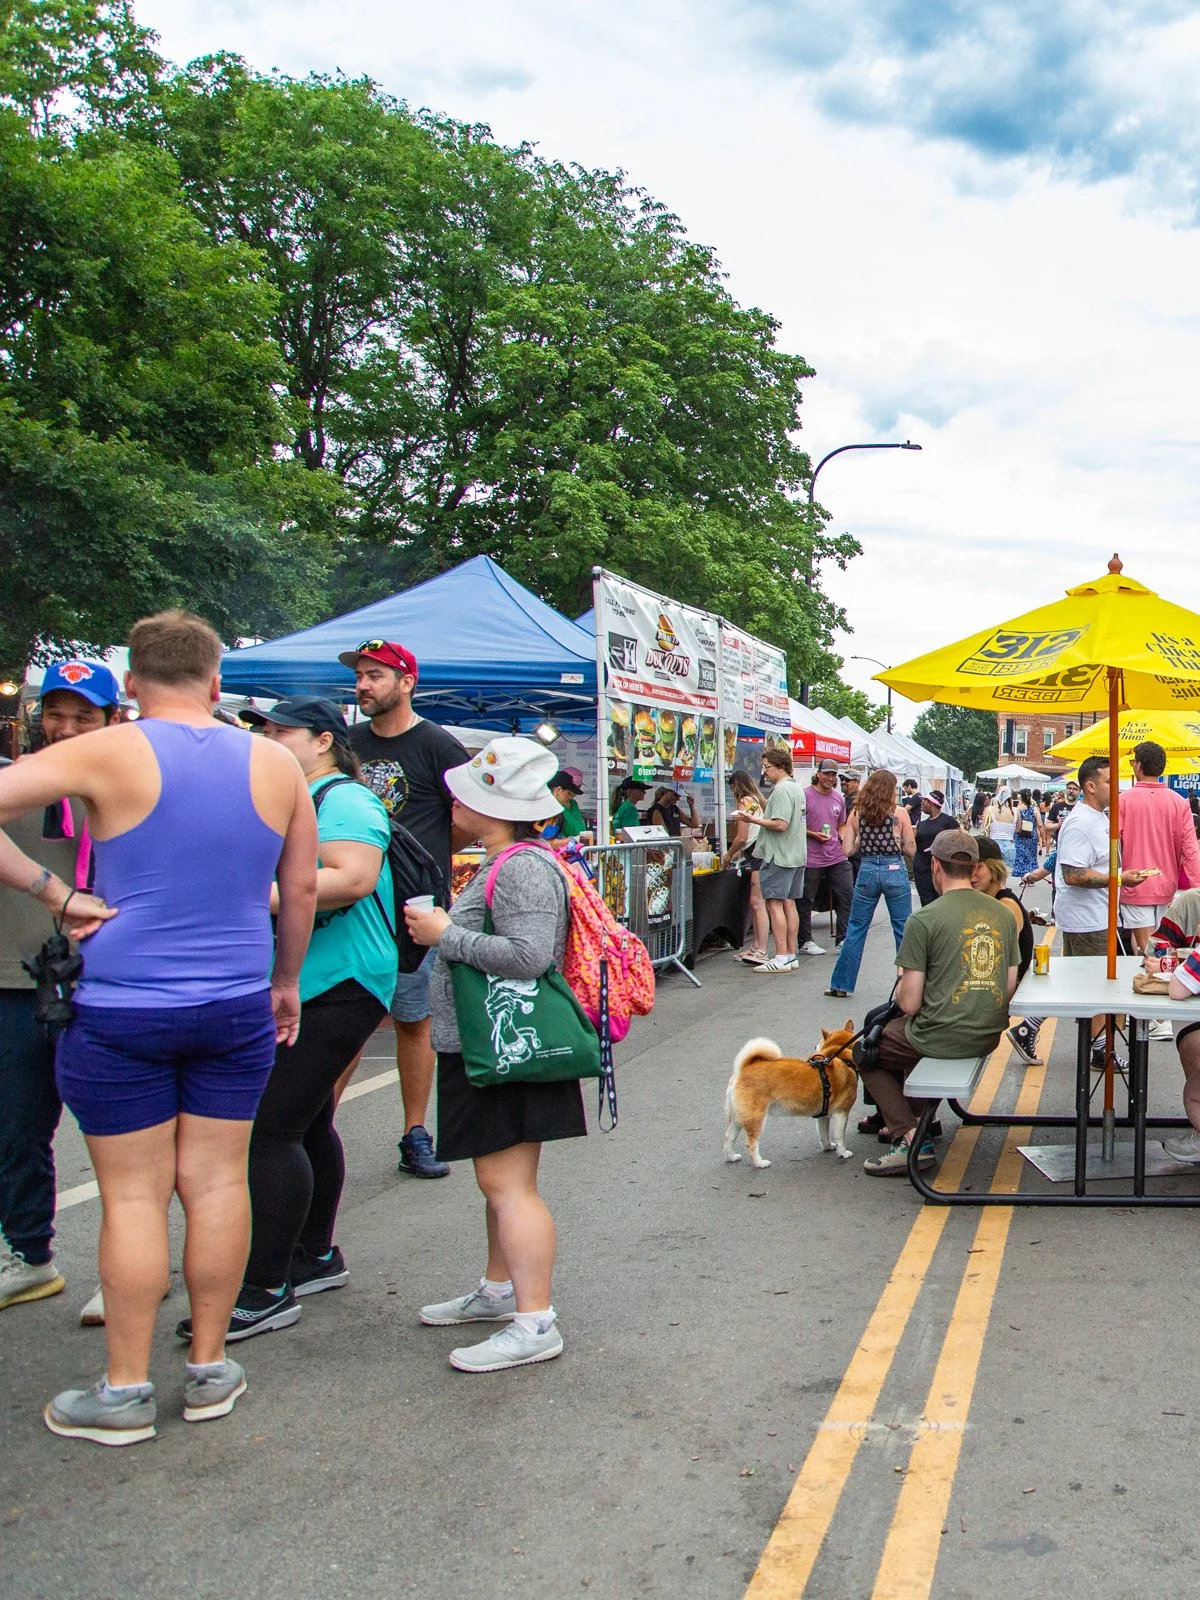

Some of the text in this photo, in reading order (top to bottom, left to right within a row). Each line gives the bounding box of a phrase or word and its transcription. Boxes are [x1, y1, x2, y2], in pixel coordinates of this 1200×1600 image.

[981, 631, 1081, 659] 312
[1181, 637, 1195, 646] a
[995, 656, 1055, 674] BEER
[1178, 773, 1200, 781] BUD
